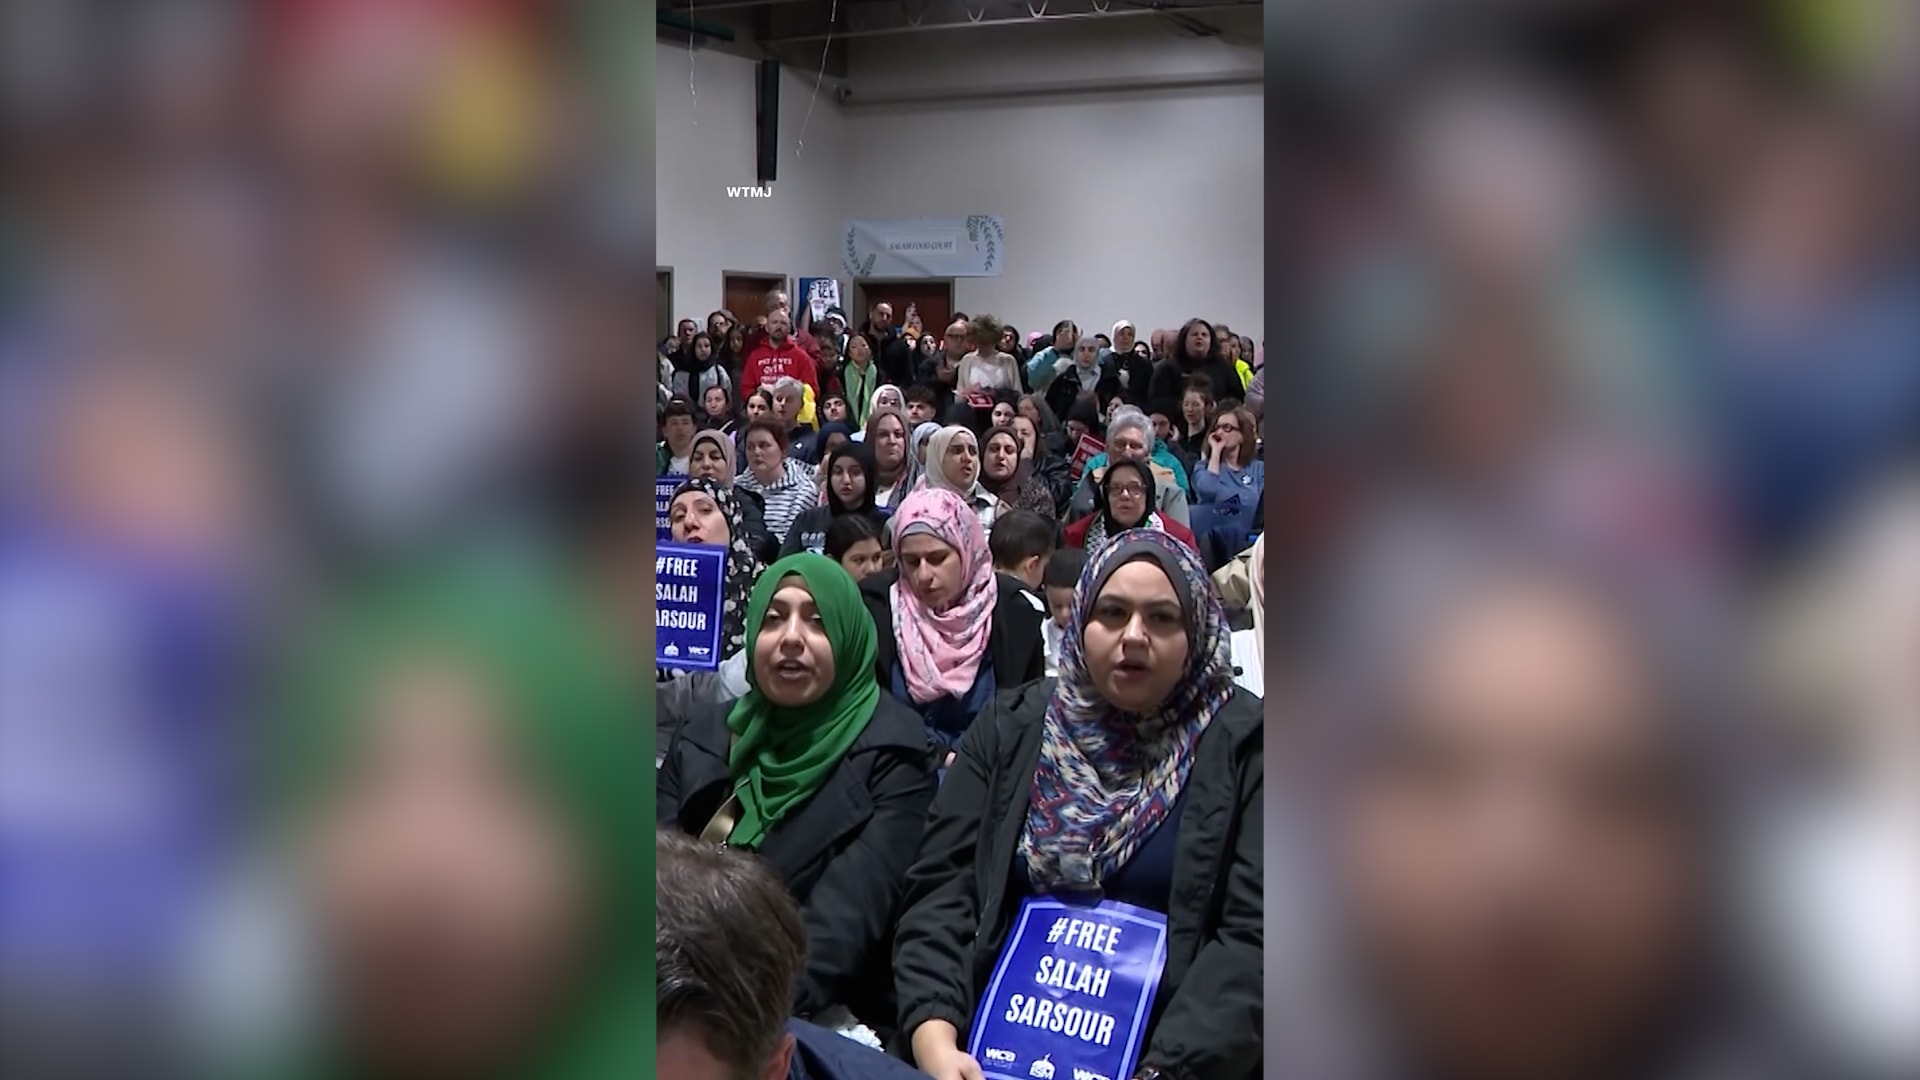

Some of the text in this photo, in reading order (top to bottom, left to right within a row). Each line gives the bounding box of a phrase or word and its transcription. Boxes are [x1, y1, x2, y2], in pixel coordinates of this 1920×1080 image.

[912, 241, 930, 250] FOOD
[931, 240, 953, 250] COURT
[656, 556, 699, 578] #FREE
[656, 582, 698, 603] SALAH
[1046, 917, 1123, 956] #FREE
[1035, 955, 1112, 998] SALAH
[1005, 993, 1116, 1047] SARSOUR
